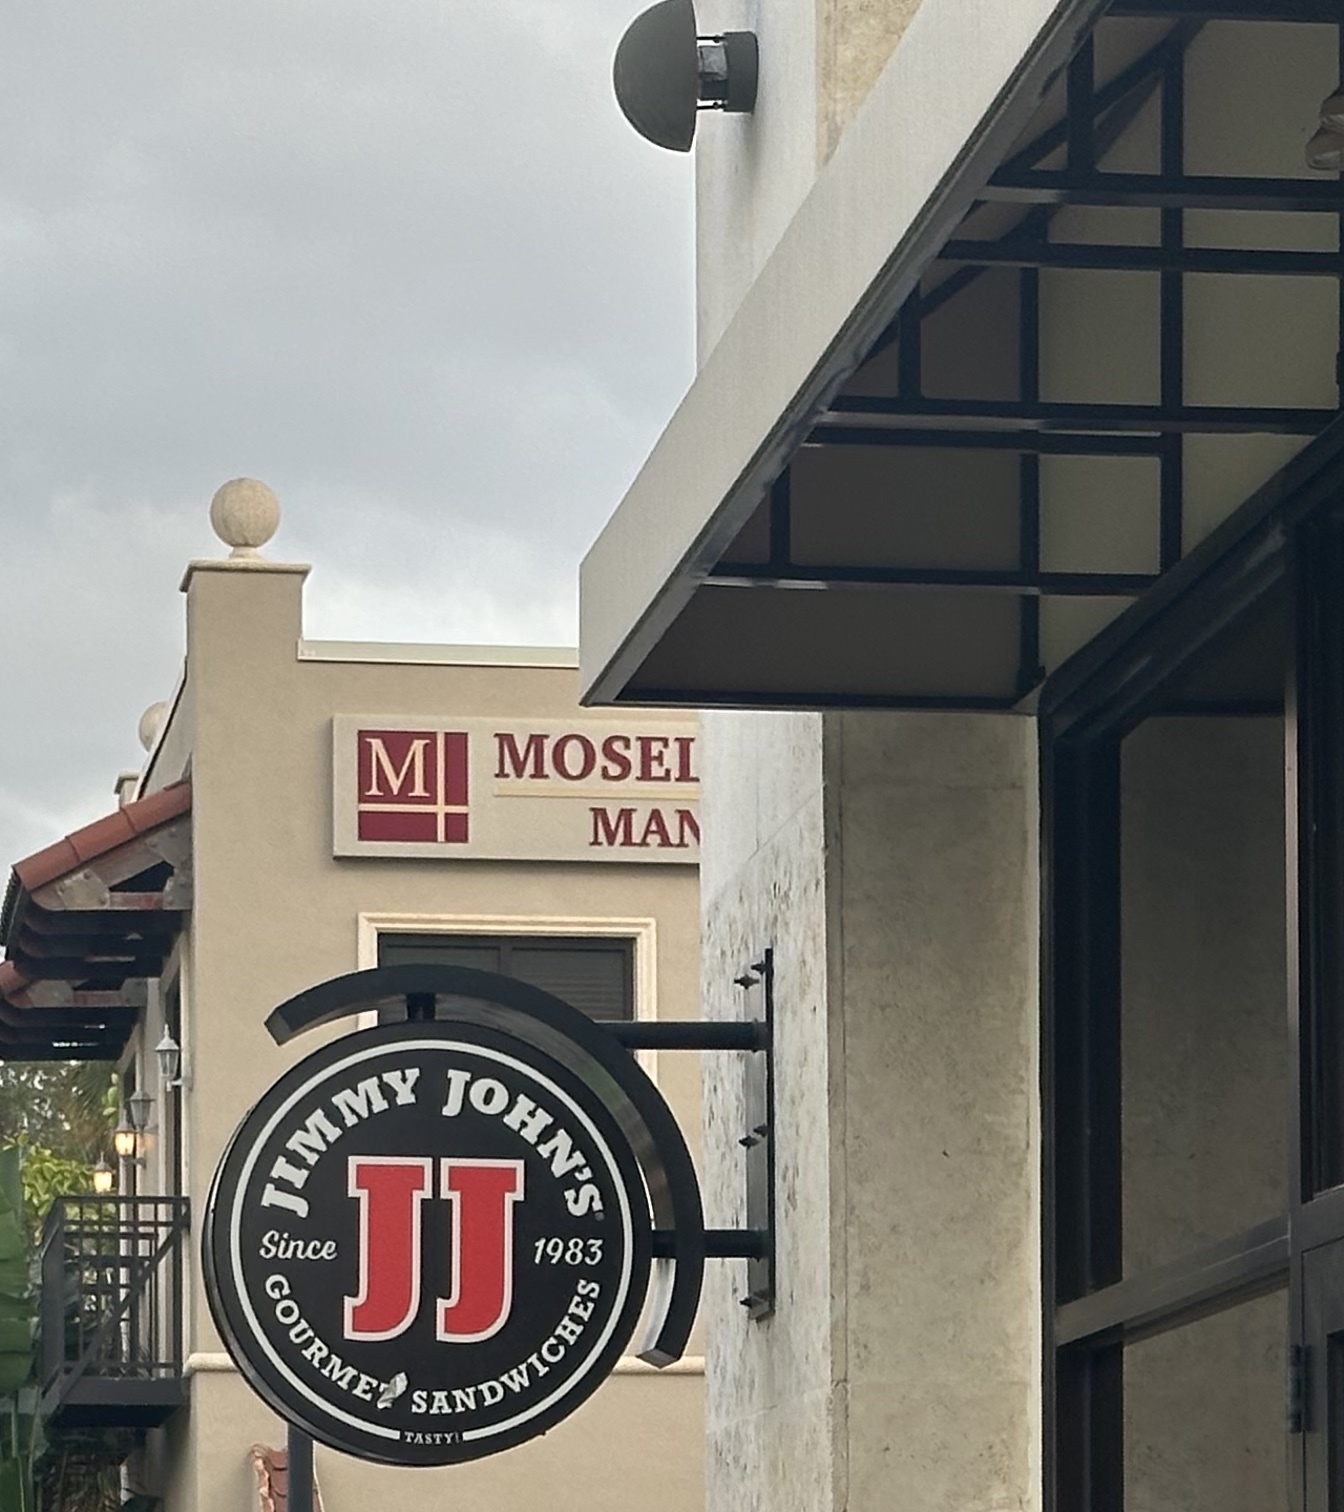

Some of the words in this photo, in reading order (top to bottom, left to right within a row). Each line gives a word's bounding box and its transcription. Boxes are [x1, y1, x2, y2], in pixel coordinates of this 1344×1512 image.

[260, 1068, 421, 1219] JIMMY
[442, 1068, 604, 1218] JOHN'S
[259, 1229, 338, 1262] Since
[343, 1155, 525, 1342] JJ
[533, 1237, 603, 1265] 1983
[411, 1279, 600, 1415] SANDWICHES
